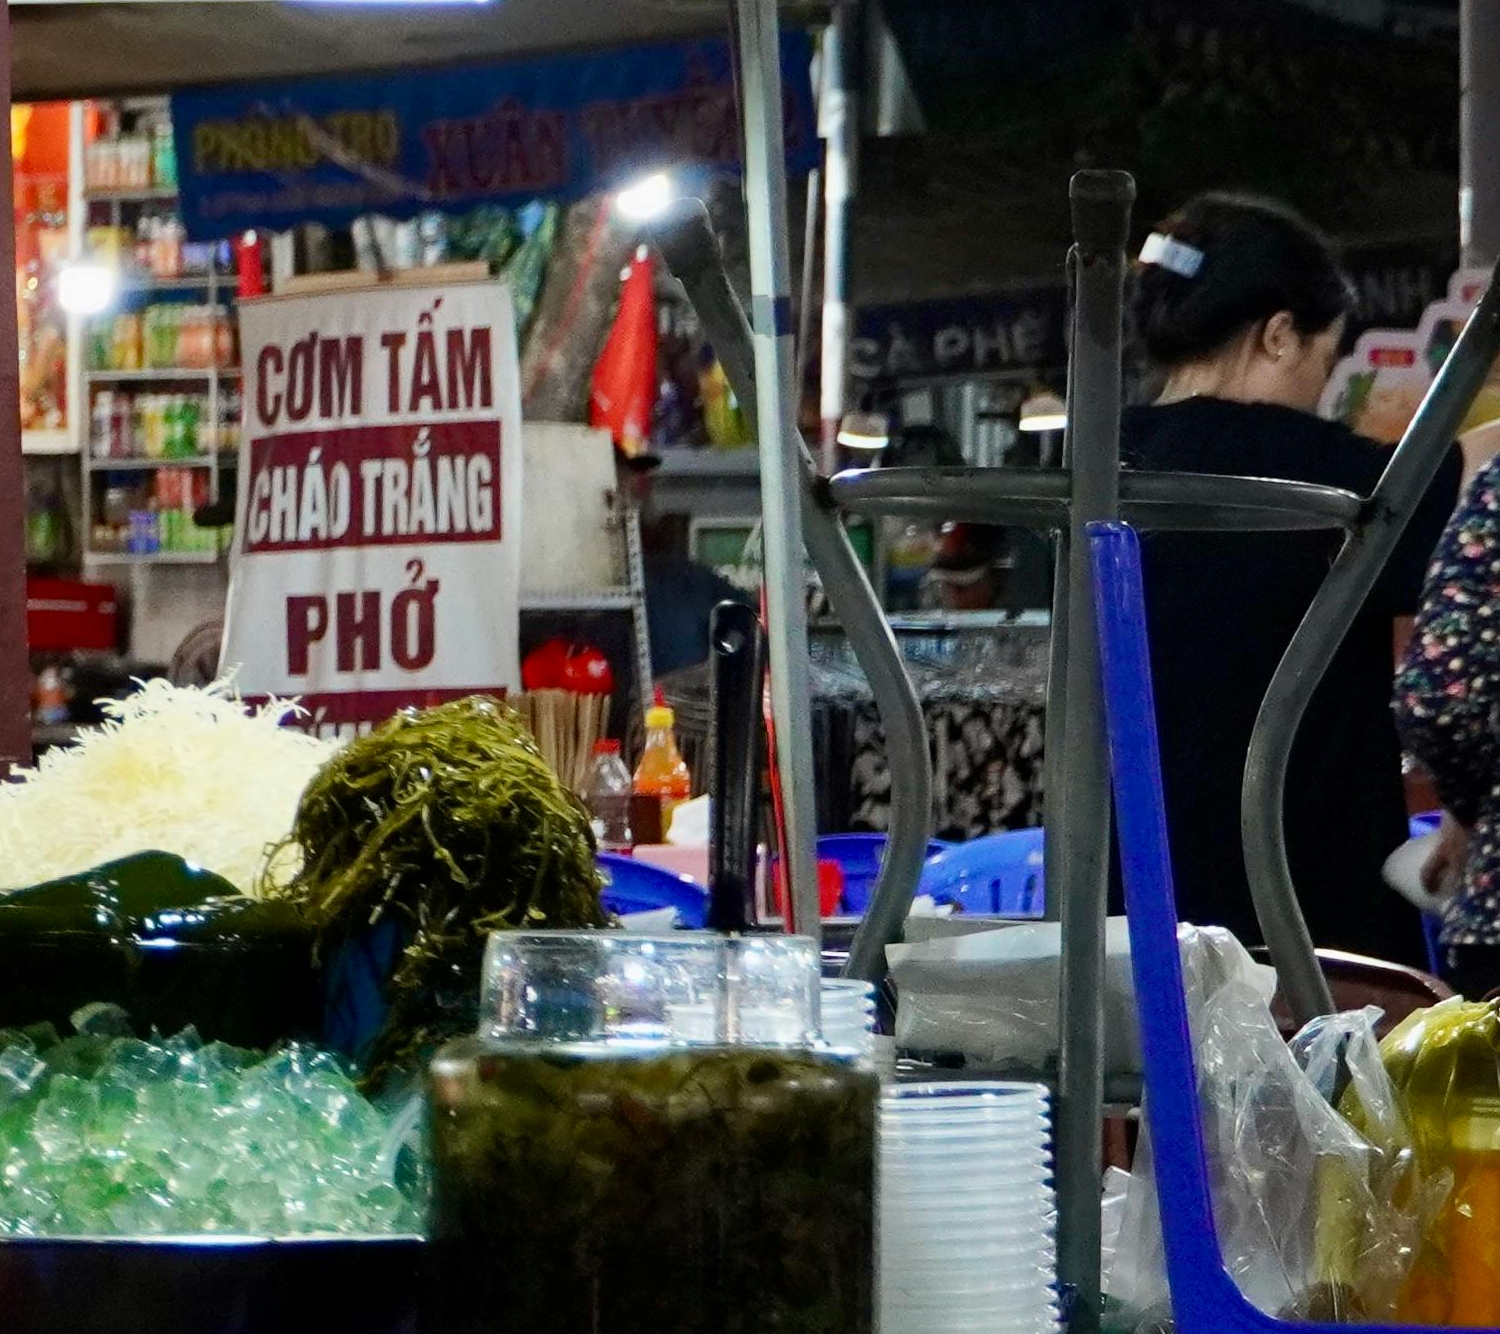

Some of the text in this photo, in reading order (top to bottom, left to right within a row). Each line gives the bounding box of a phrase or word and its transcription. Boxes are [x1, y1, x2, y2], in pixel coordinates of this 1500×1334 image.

[255, 296, 494, 427] CƠM TẤM
[247, 427, 495, 545] CHÁO TRẮNG
[285, 556, 441, 677] PHỞ
